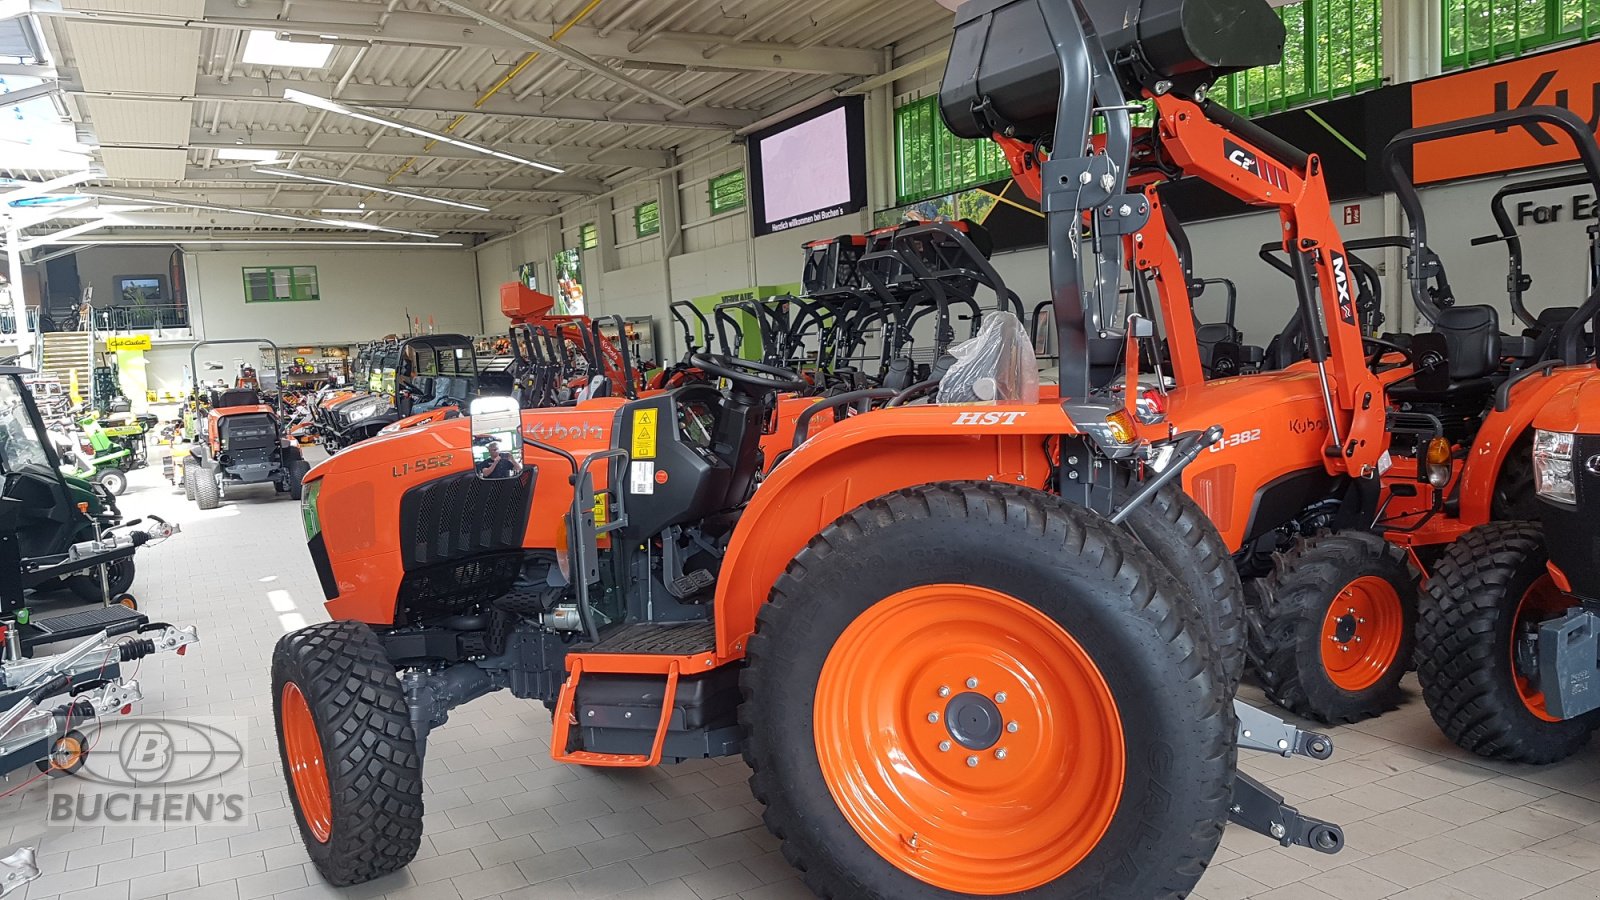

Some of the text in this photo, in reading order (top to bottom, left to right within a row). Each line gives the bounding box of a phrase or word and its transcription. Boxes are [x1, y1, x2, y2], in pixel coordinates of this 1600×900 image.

[1517, 201, 1563, 226] For
[772, 220, 789, 232] Herzlich
[1332, 256, 1350, 304] MX
[952, 411, 1027, 426] HST
[525, 420, 603, 440] Kubota
